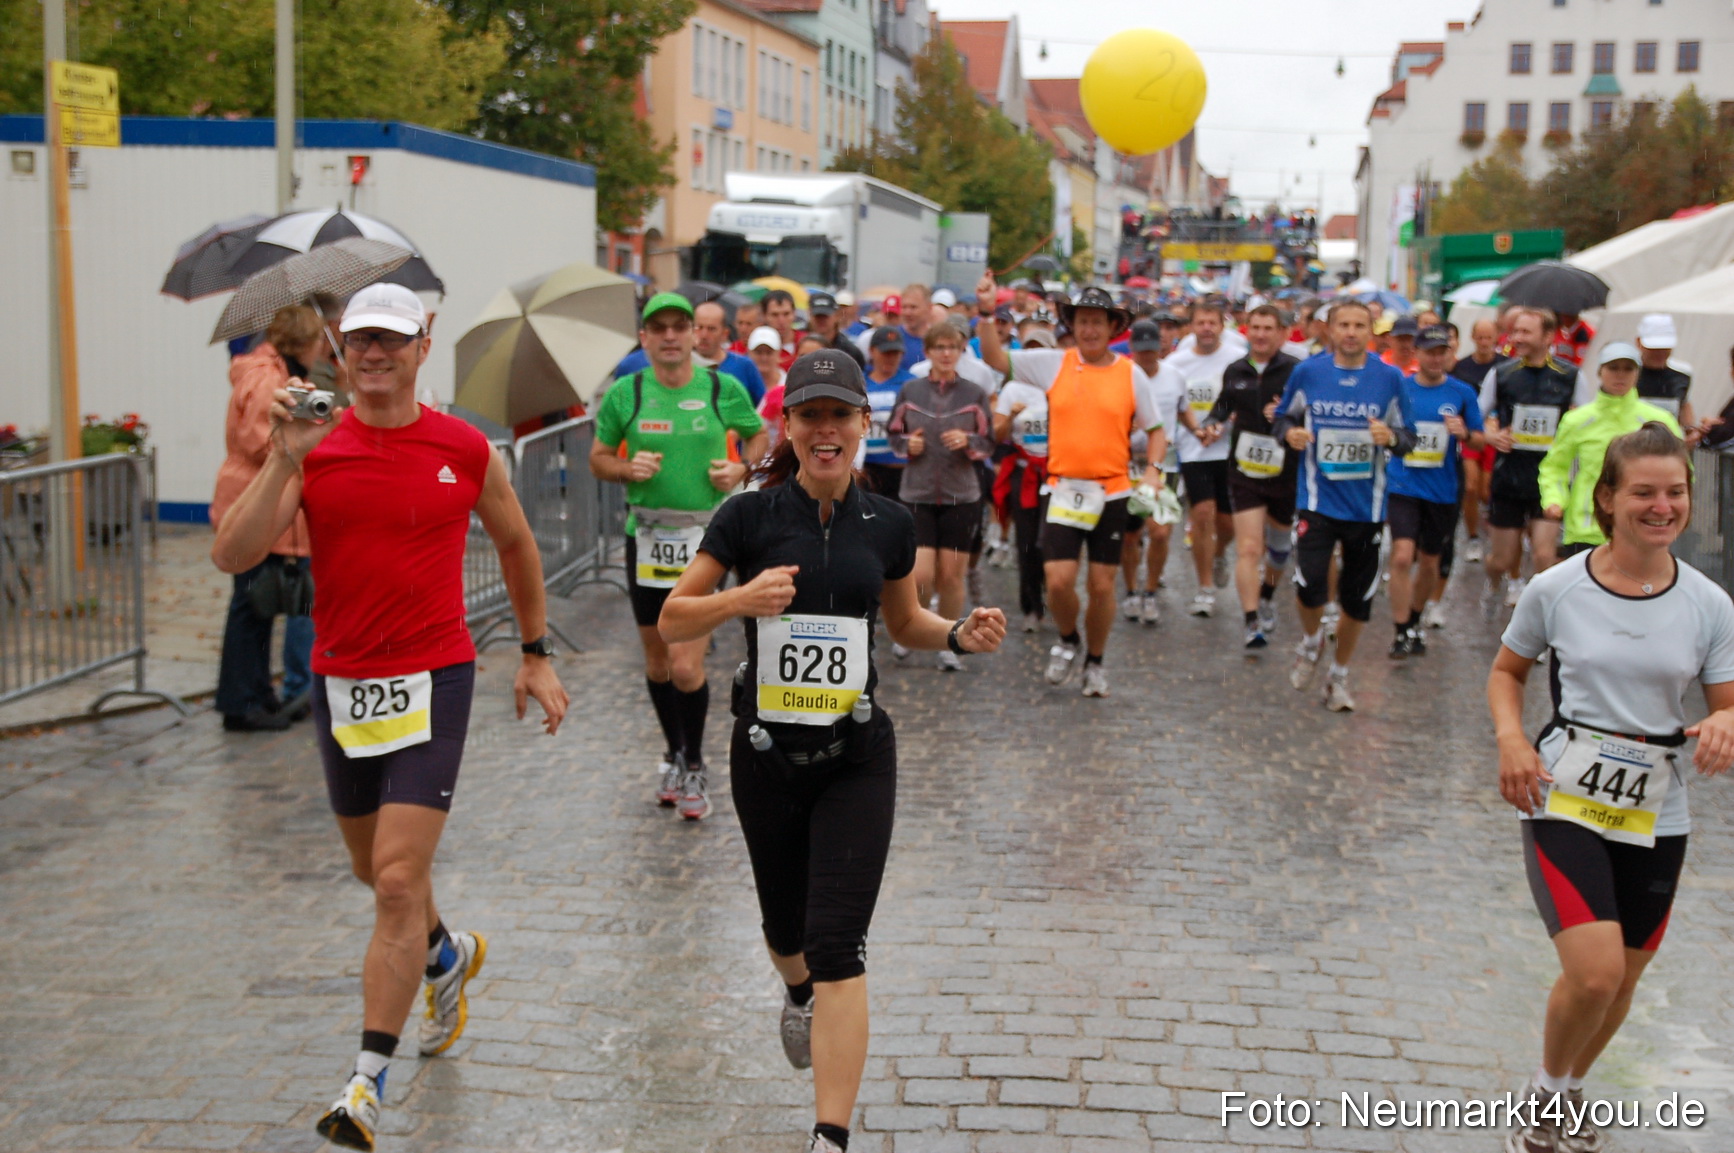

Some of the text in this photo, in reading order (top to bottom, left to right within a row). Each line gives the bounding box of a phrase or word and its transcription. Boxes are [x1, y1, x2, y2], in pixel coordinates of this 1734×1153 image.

[813, 360, 835, 370] 5.11
[1312, 401, 1380, 418] SYSCAD
[1247, 446, 1273, 463] 487
[1323, 443, 1370, 462] 2796
[1074, 492, 1084, 509] 9
[650, 543, 689, 565] 494
[790, 622, 837, 634] BOCK
[779, 643, 847, 685] 628
[350, 679, 410, 720] 825
[783, 691, 838, 709] Claudia
[1577, 762, 1649, 806] 444
